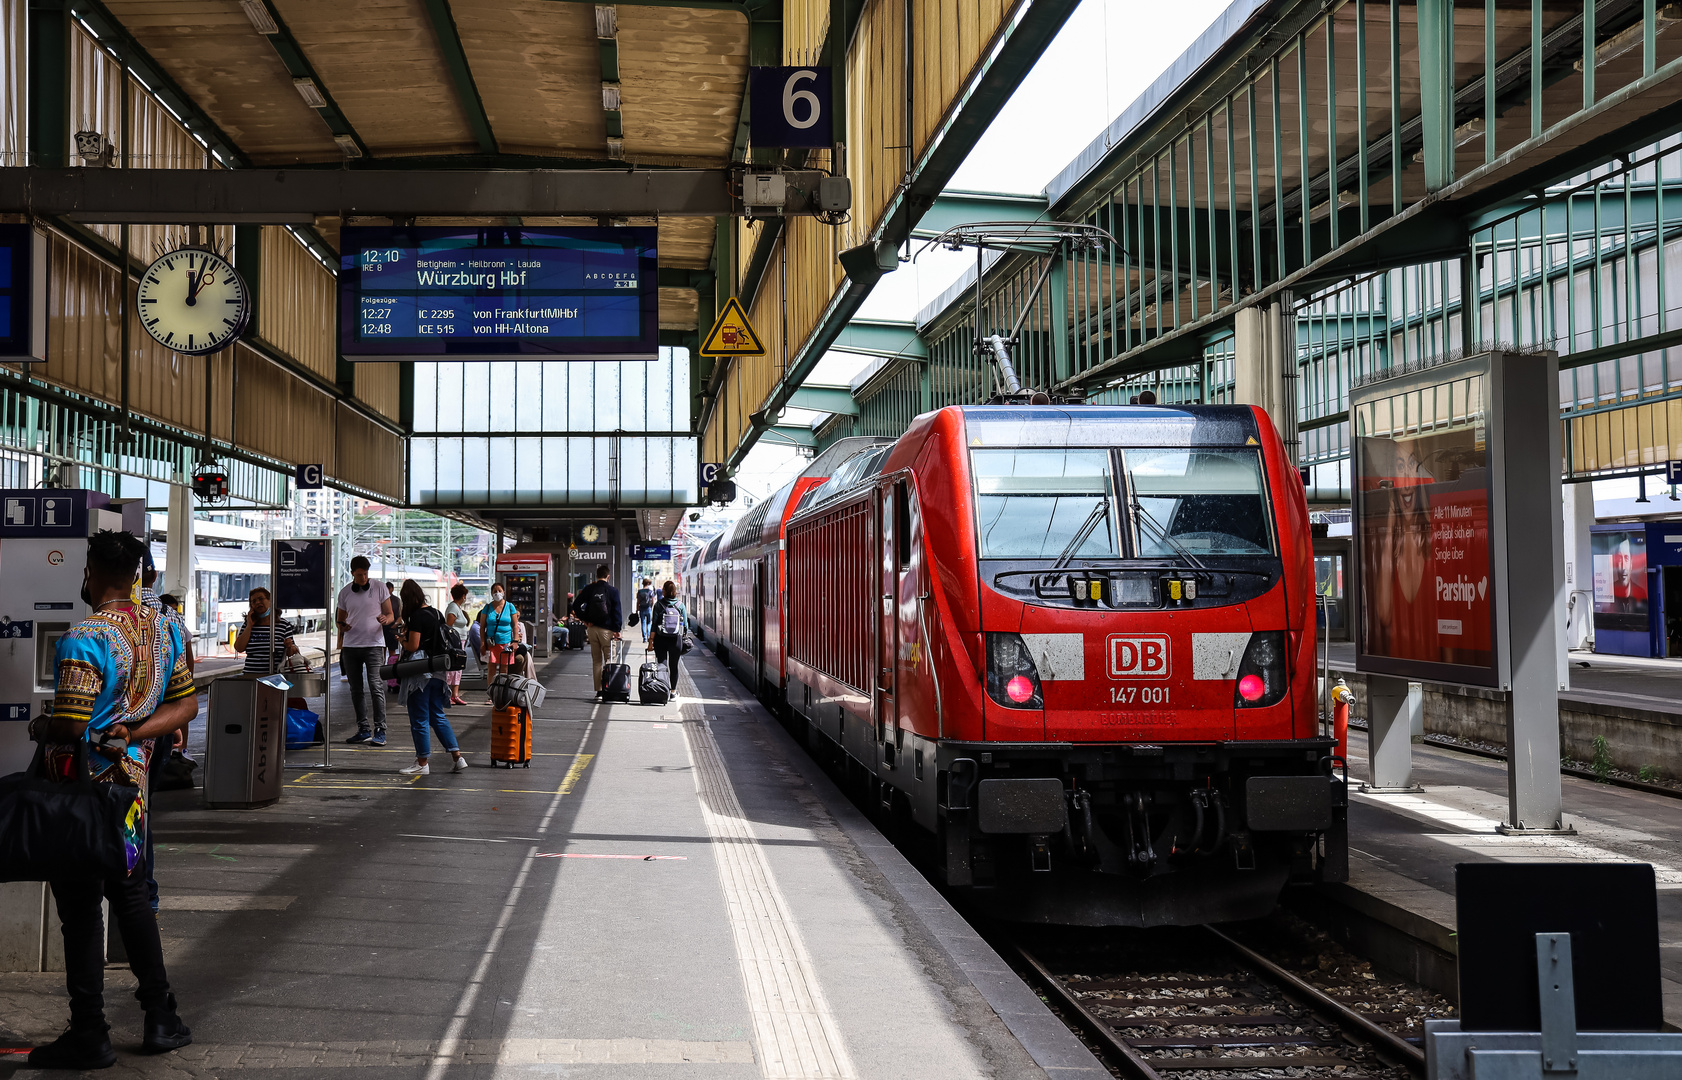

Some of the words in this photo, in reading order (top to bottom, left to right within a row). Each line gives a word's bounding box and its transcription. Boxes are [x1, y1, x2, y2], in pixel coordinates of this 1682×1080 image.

[782, 70, 821, 129] 6
[363, 250, 399, 262] 12:10
[362, 264, 374, 272] IRE
[377, 264, 383, 272] 8
[417, 260, 457, 270] Bietigheim
[469, 260, 506, 268] Heilbronn
[517, 260, 541, 268] Lauda
[417, 271, 496, 289] Würzburg
[500, 271, 527, 286] Hbf
[361, 297, 398, 305] Folgezüge:
[362, 309, 392, 319] 12:27
[418, 310, 428, 319] IC
[431, 310, 455, 319] 2295
[473, 311, 492, 319] von
[495, 308, 578, 319] Frankfurt(M)Hbf
[362, 324, 392, 334] 12:48
[418, 325, 434, 334] ICE
[436, 325, 455, 334] 515
[473, 326, 492, 334] von
[495, 323, 549, 334] HH-Altona
[304, 465, 320, 484] G
[1670, 461, 1681, 479] F
[1434, 505, 1444, 519] Alle
[1450, 505, 1472, 518] Minuten
[1434, 525, 1454, 539] verliebt
[1454, 525, 1465, 539] sich
[1465, 525, 1475, 538] ein
[634, 544, 641, 555] F
[1435, 546, 1451, 563] Single
[1452, 546, 1465, 559] über
[1436, 574, 1476, 610] Parship
[1113, 640, 1166, 673] DB
[1109, 687, 1137, 703] 147
[1142, 687, 1170, 703] 001
[257, 717, 268, 784] Abfall
